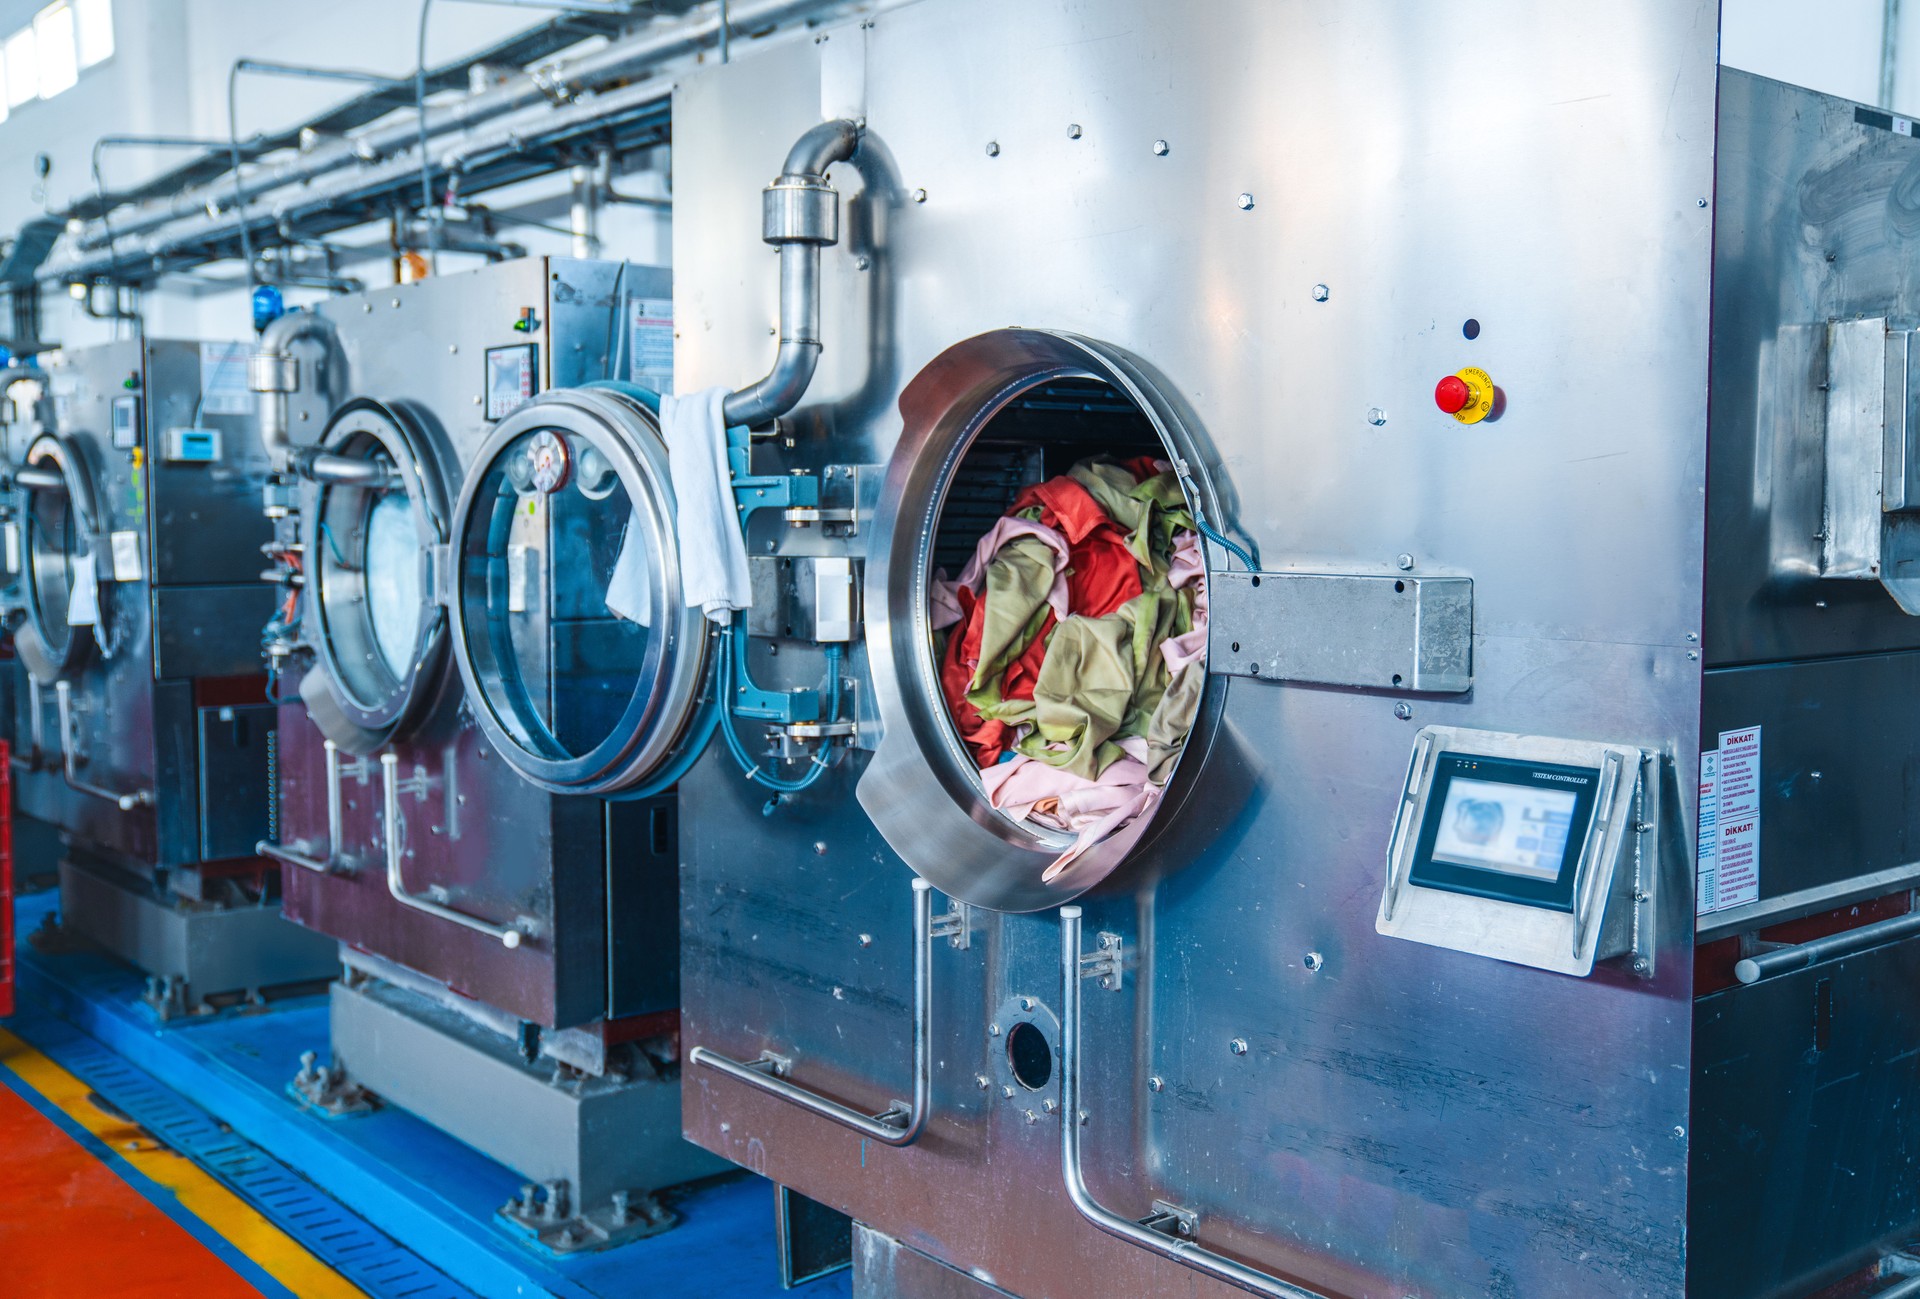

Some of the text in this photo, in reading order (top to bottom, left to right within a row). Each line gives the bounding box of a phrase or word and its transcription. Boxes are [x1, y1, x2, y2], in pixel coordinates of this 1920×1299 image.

[1465, 369, 1491, 389] EMERGENCY
[1726, 733, 1754, 745] DİKKAT!
[1552, 775, 1588, 784] CONTROLLER
[1725, 823, 1753, 836] DİKKAT!
